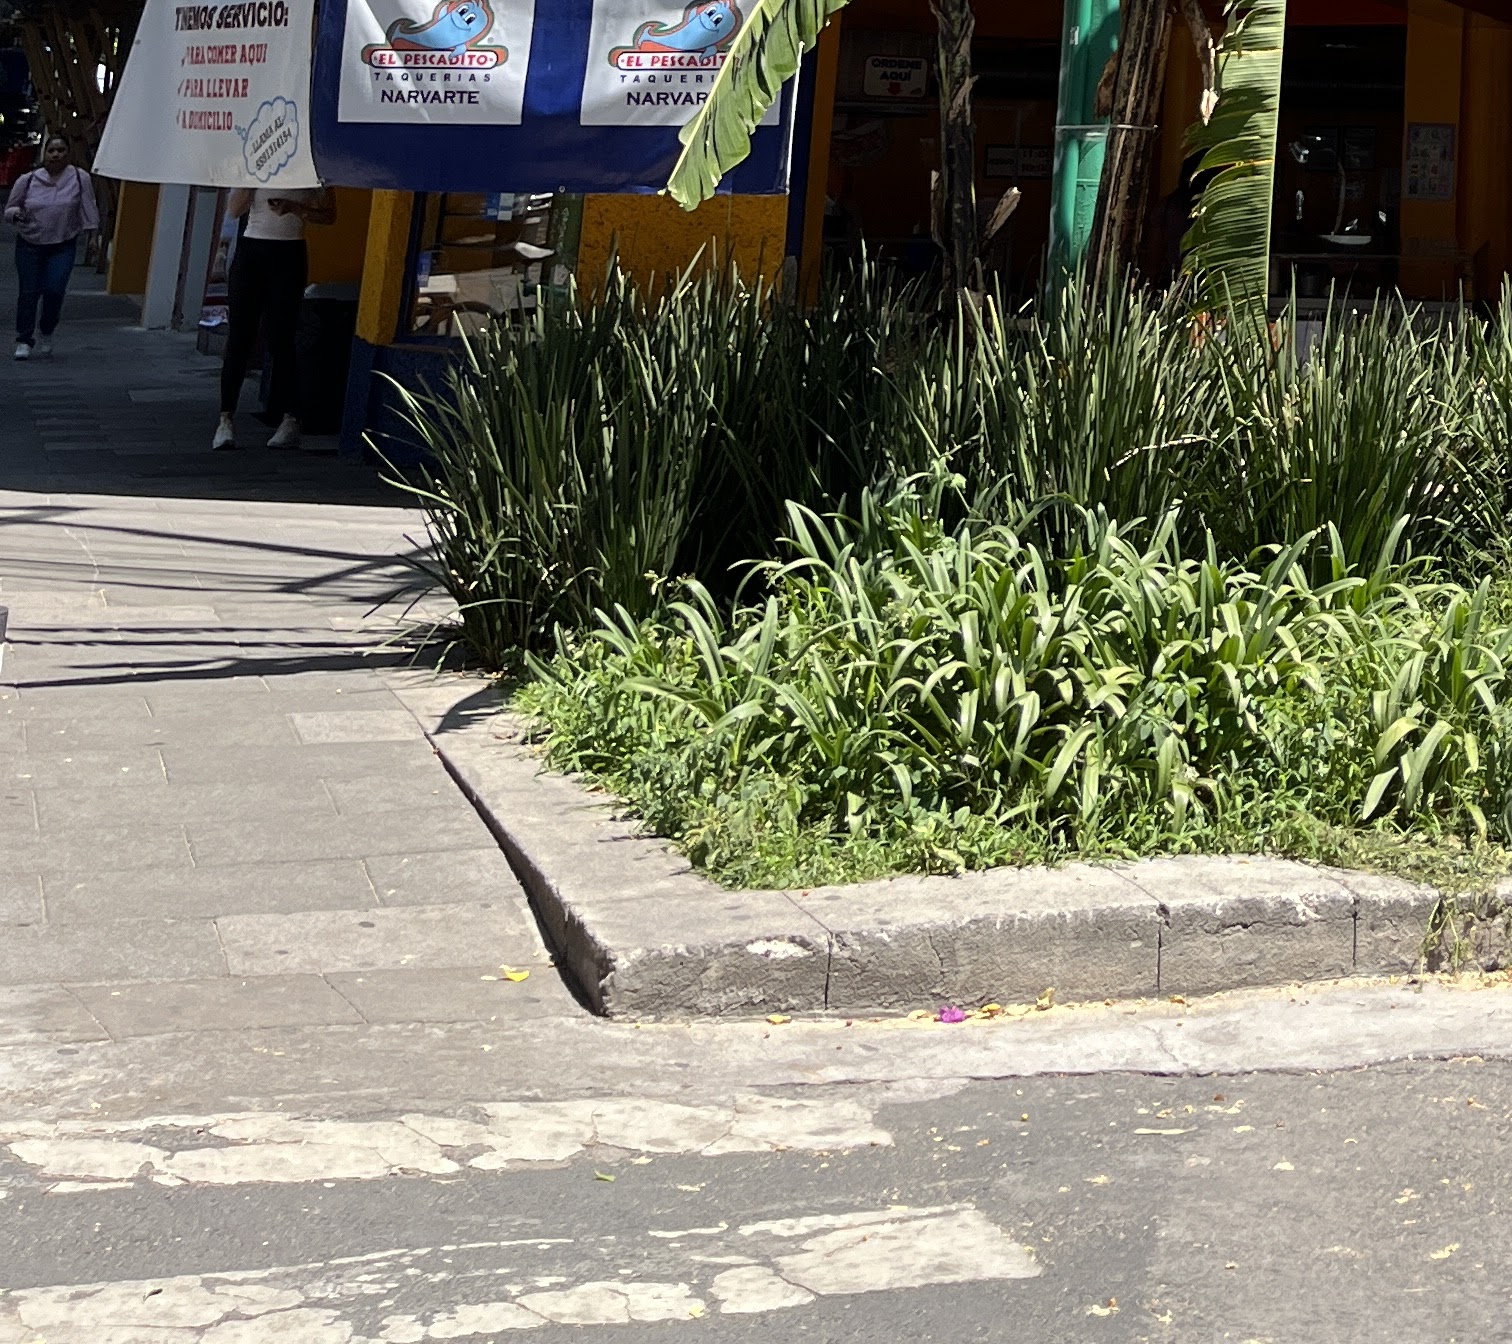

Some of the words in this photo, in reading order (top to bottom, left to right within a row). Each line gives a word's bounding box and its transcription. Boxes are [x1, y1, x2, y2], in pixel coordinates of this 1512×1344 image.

[216, 0, 289, 29] SERVICIO:
[207, 44, 237, 64] COMER
[239, 43, 268, 65] AQUI
[378, 53, 396, 66] EL
[403, 53, 488, 66] PESCADITO
[626, 55, 642, 67] EL
[651, 55, 727, 67] PESCADIT
[871, 57, 922, 70] ORDENE
[374, 72, 491, 82] TAQUERIAS
[619, 74, 715, 83] TAQUERI
[184, 78, 204, 98] PARA
[206, 78, 249, 98] LLEVAR
[380, 89, 480, 104] NARVARTE
[626, 92, 709, 105] NARVAR
[188, 110, 233, 130] DOMICILIO
